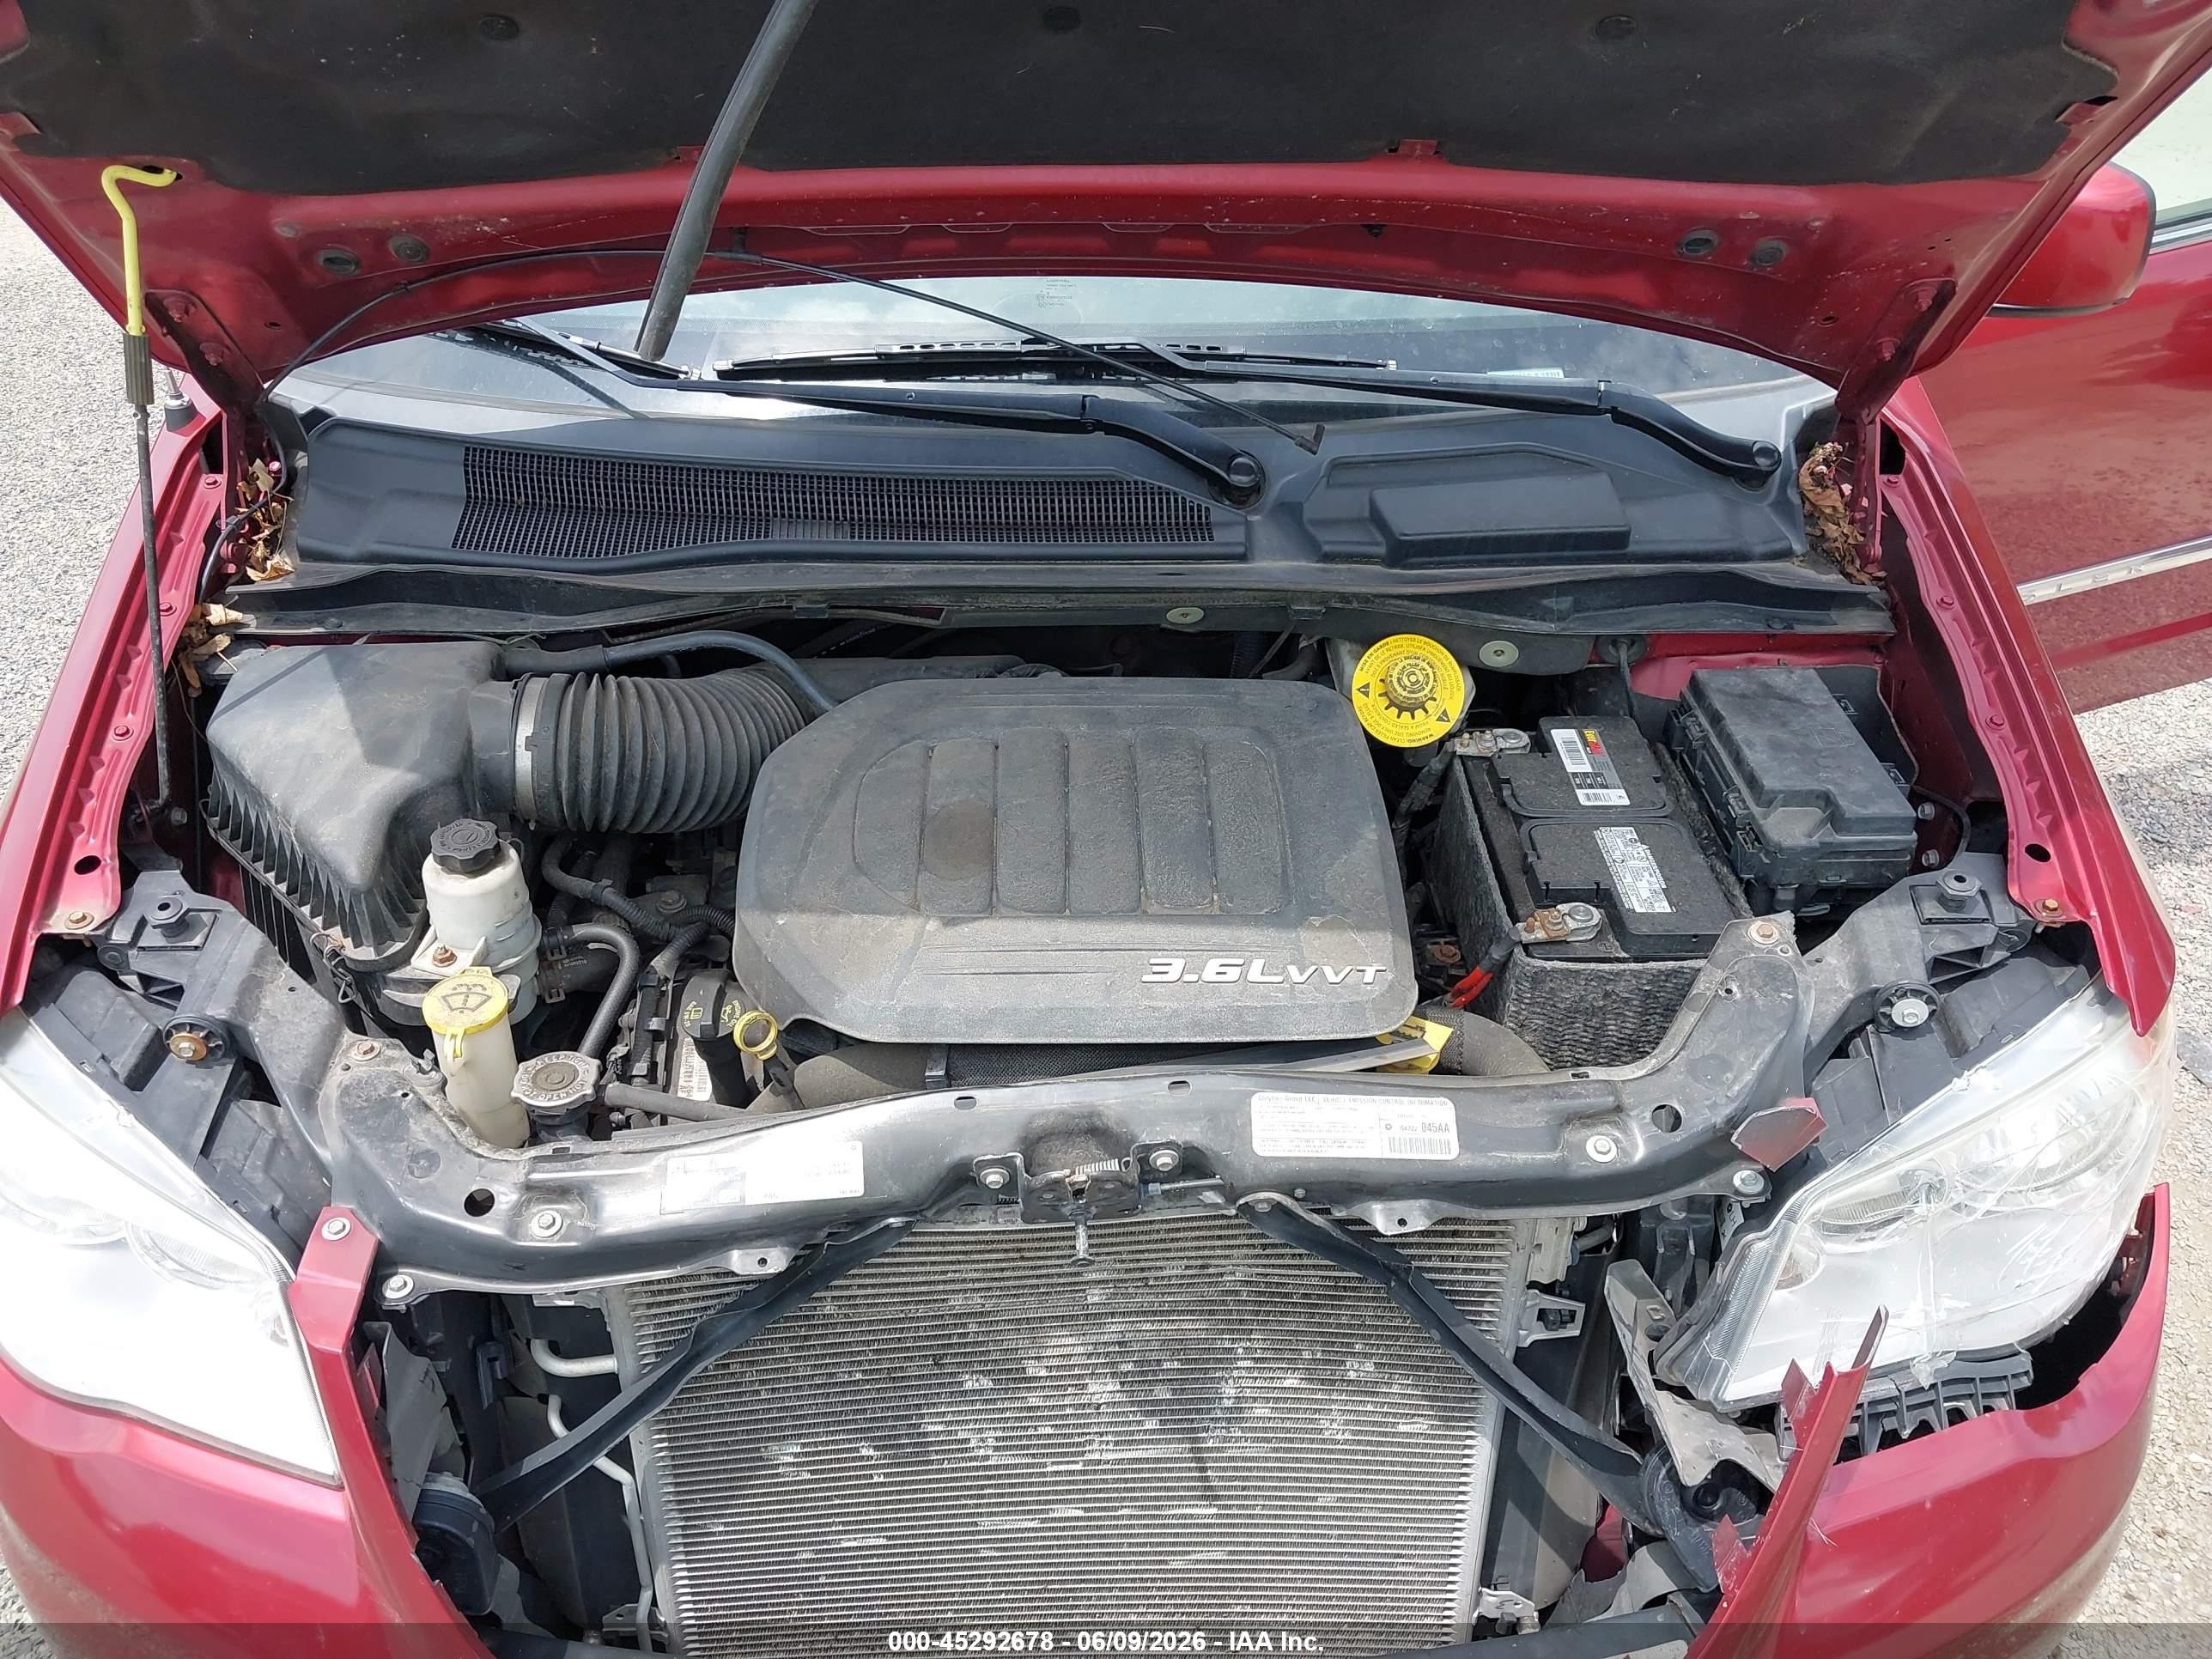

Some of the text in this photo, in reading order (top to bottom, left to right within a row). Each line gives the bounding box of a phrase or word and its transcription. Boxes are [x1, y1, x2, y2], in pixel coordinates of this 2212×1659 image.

[1373, 641, 1388, 653] GARDE
[732, 1000, 741, 1018] ENGINE
[1379, 1097, 1405, 1106] CONTROL
